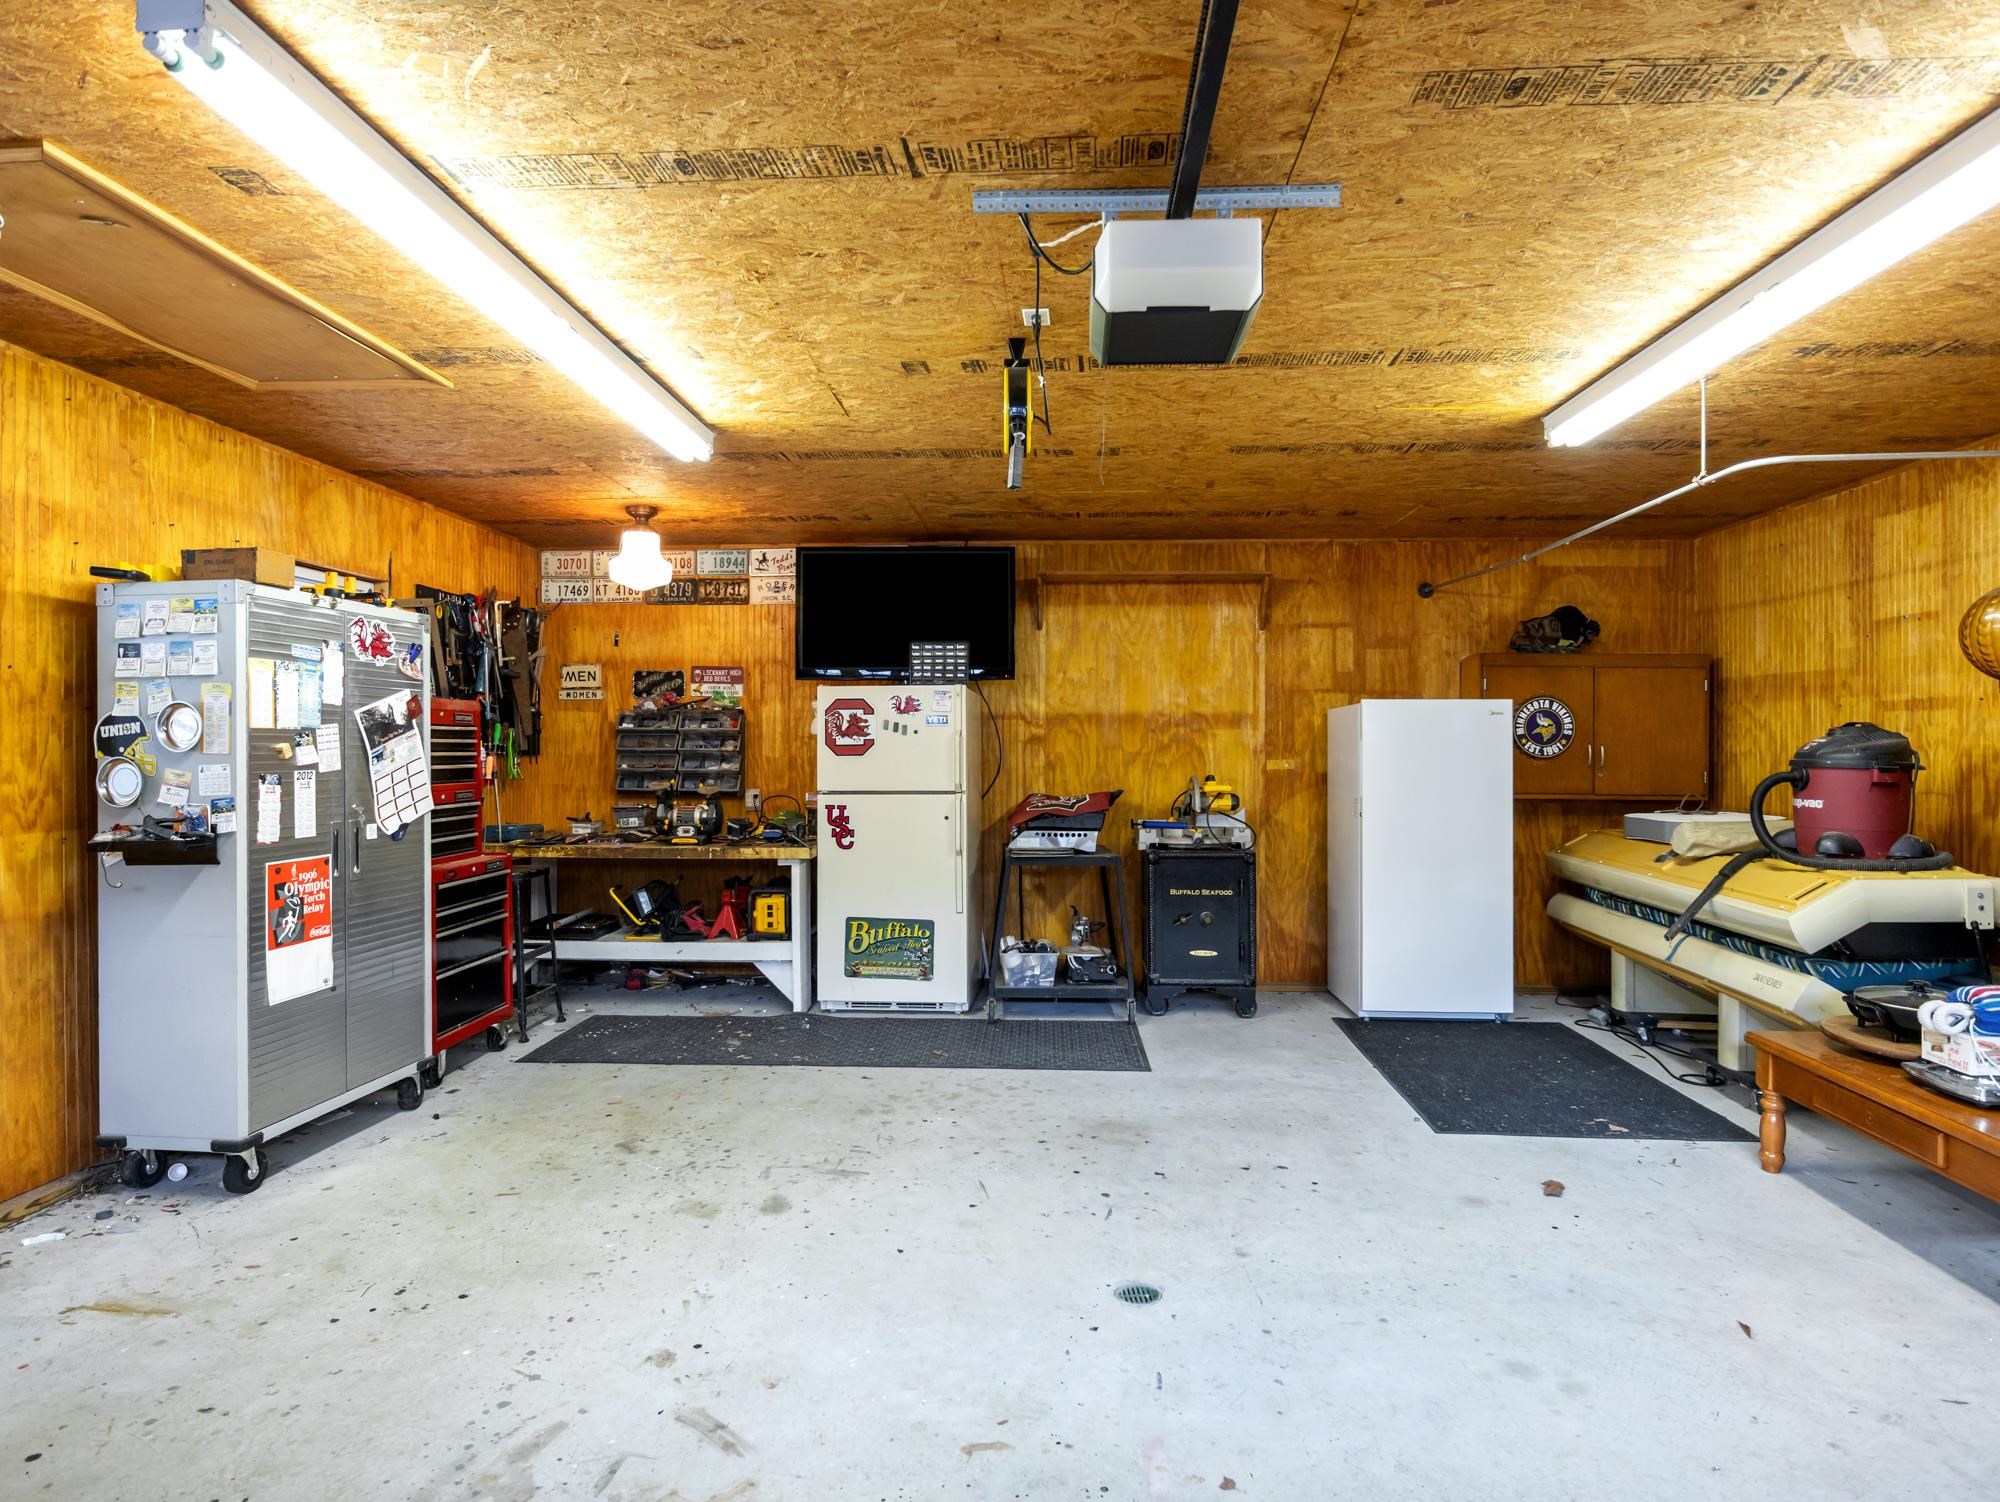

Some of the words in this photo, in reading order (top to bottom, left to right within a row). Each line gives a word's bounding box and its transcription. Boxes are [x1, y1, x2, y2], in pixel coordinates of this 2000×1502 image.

[556, 558, 587, 570] 30701
[714, 557, 745, 569] 18944
[558, 585, 588, 596] 17469
[595, 585, 608, 596] KT
[664, 582, 692, 597] 4379
[757, 580, 796, 592] ROPER
[564, 671, 597, 682] MEN
[927, 715, 947, 723] YETI
[1516, 700, 1550, 735] MINNESOTA
[1551, 702, 1573, 735] VIKINGS
[100, 721, 141, 738] UNION
[1524, 742, 1541, 755] EST.
[1543, 742, 1563, 756] 1961
[296, 771, 314, 780] 2012
[825, 804, 855, 850] USC
[298, 868, 318, 884] 1996
[284, 878, 330, 897] Olympic
[1201, 888, 1233, 896] SEAFOOD
[303, 891, 326, 904] Torch
[303, 903, 325, 915] Relay
[848, 921, 931, 955] Buffalo
[867, 943, 900, 956] Seafood
